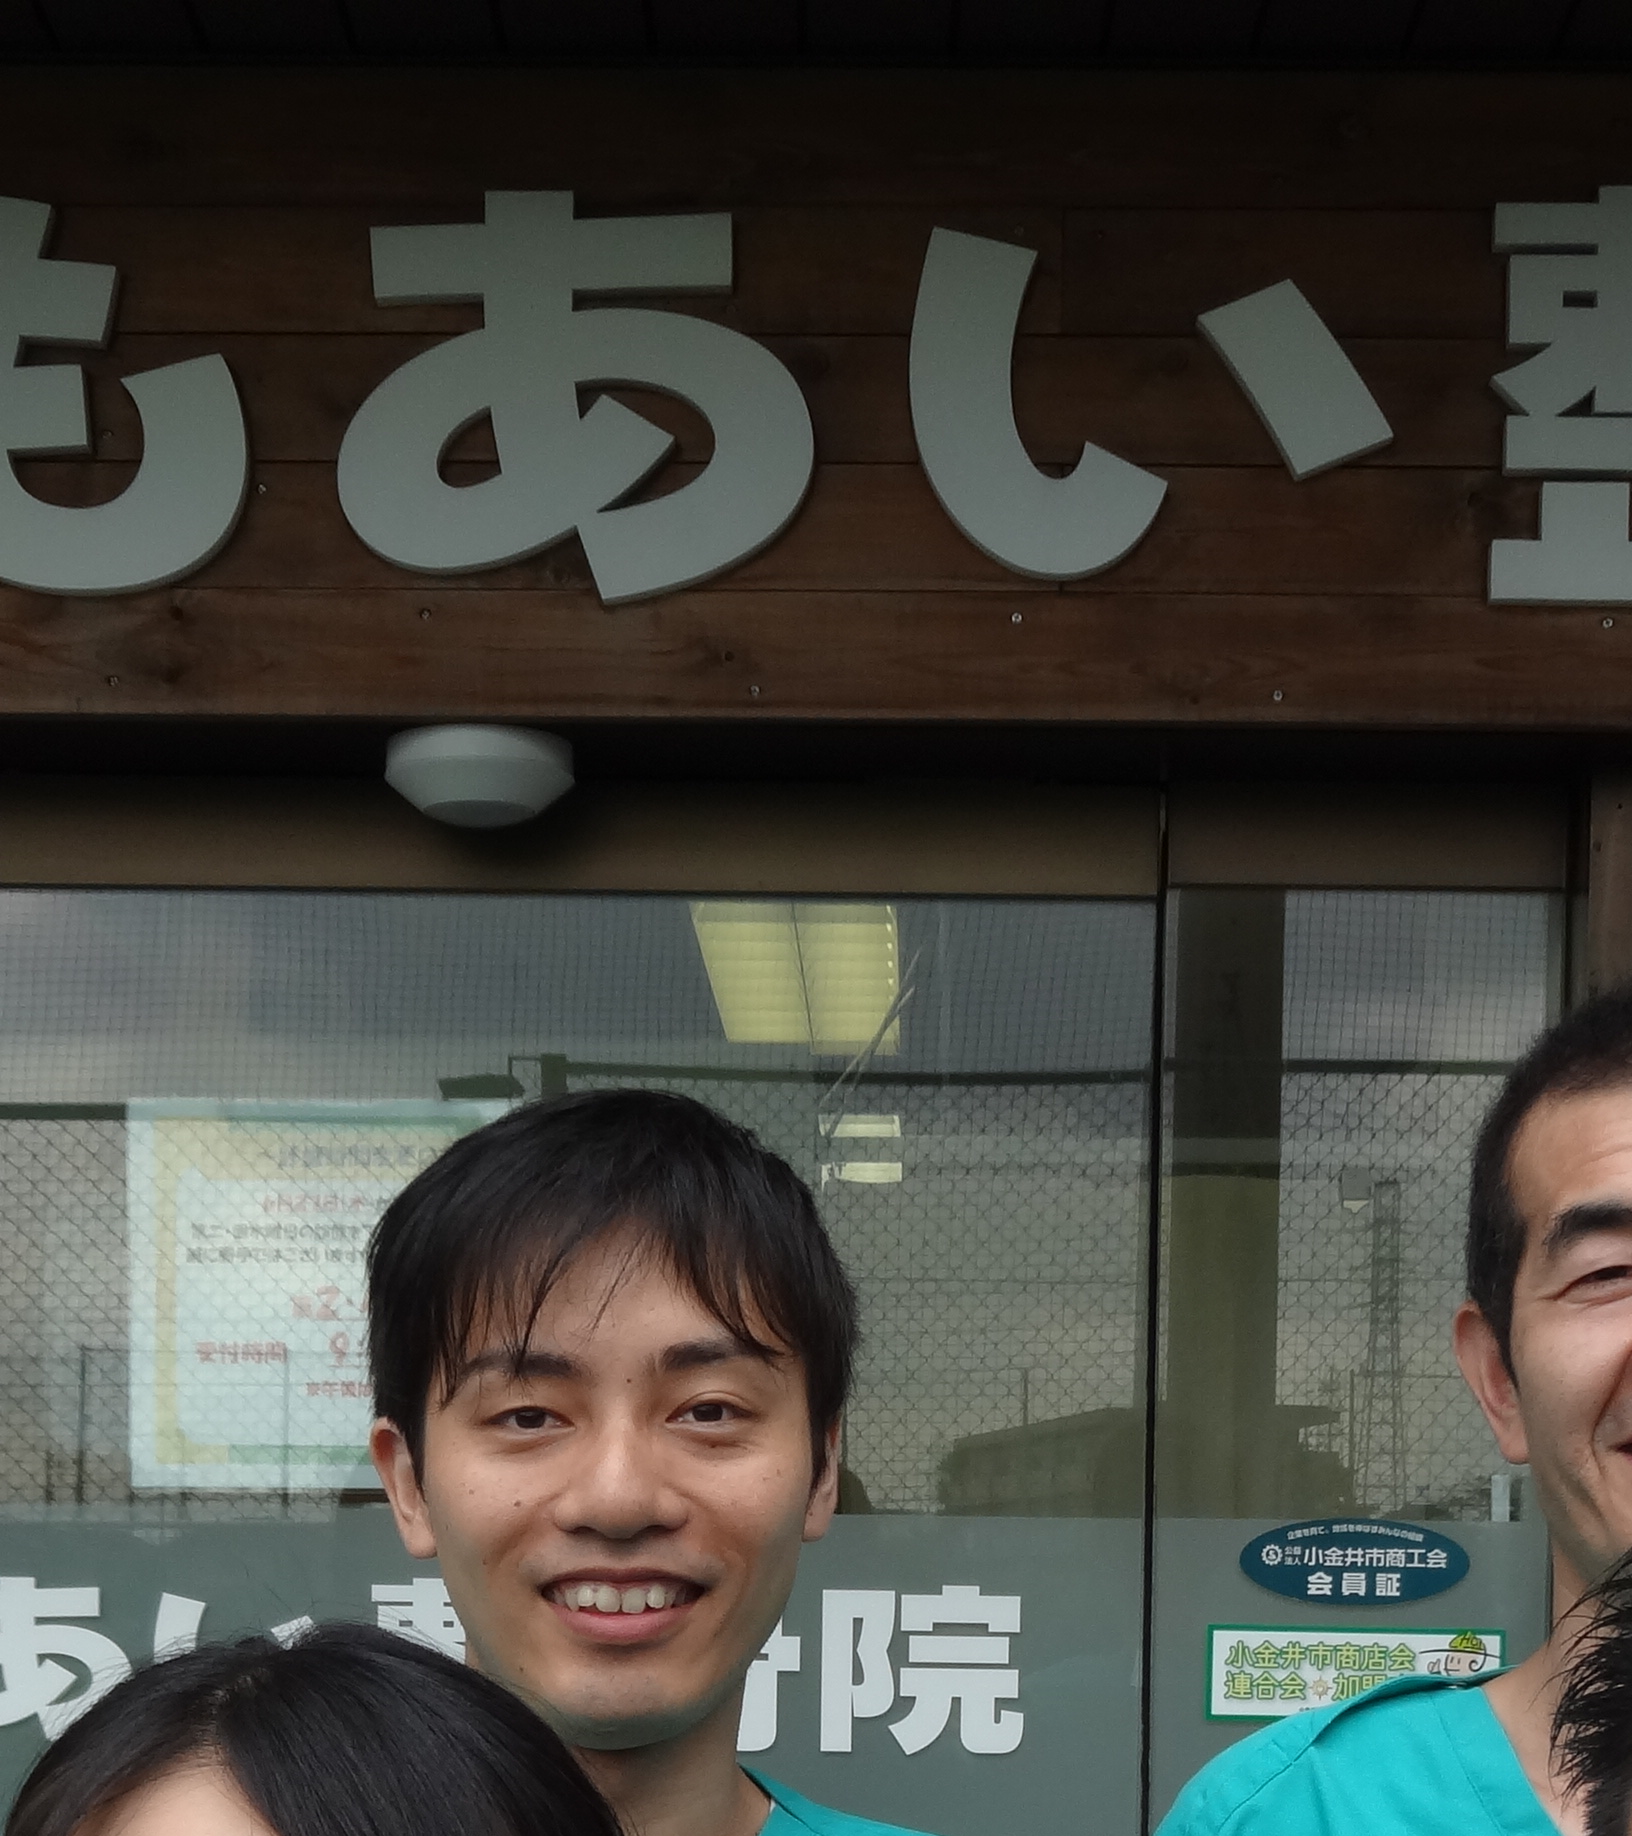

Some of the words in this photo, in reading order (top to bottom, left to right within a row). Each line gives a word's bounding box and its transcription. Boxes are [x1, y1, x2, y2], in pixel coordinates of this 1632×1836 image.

[1303, 1546, 1448, 1569] 小金井市商工会
[1306, 1571, 1402, 1597] 会員証
[1224, 1641, 1416, 1672] 小金井市商店会
[1224, 1671, 1306, 1700] 連合会
